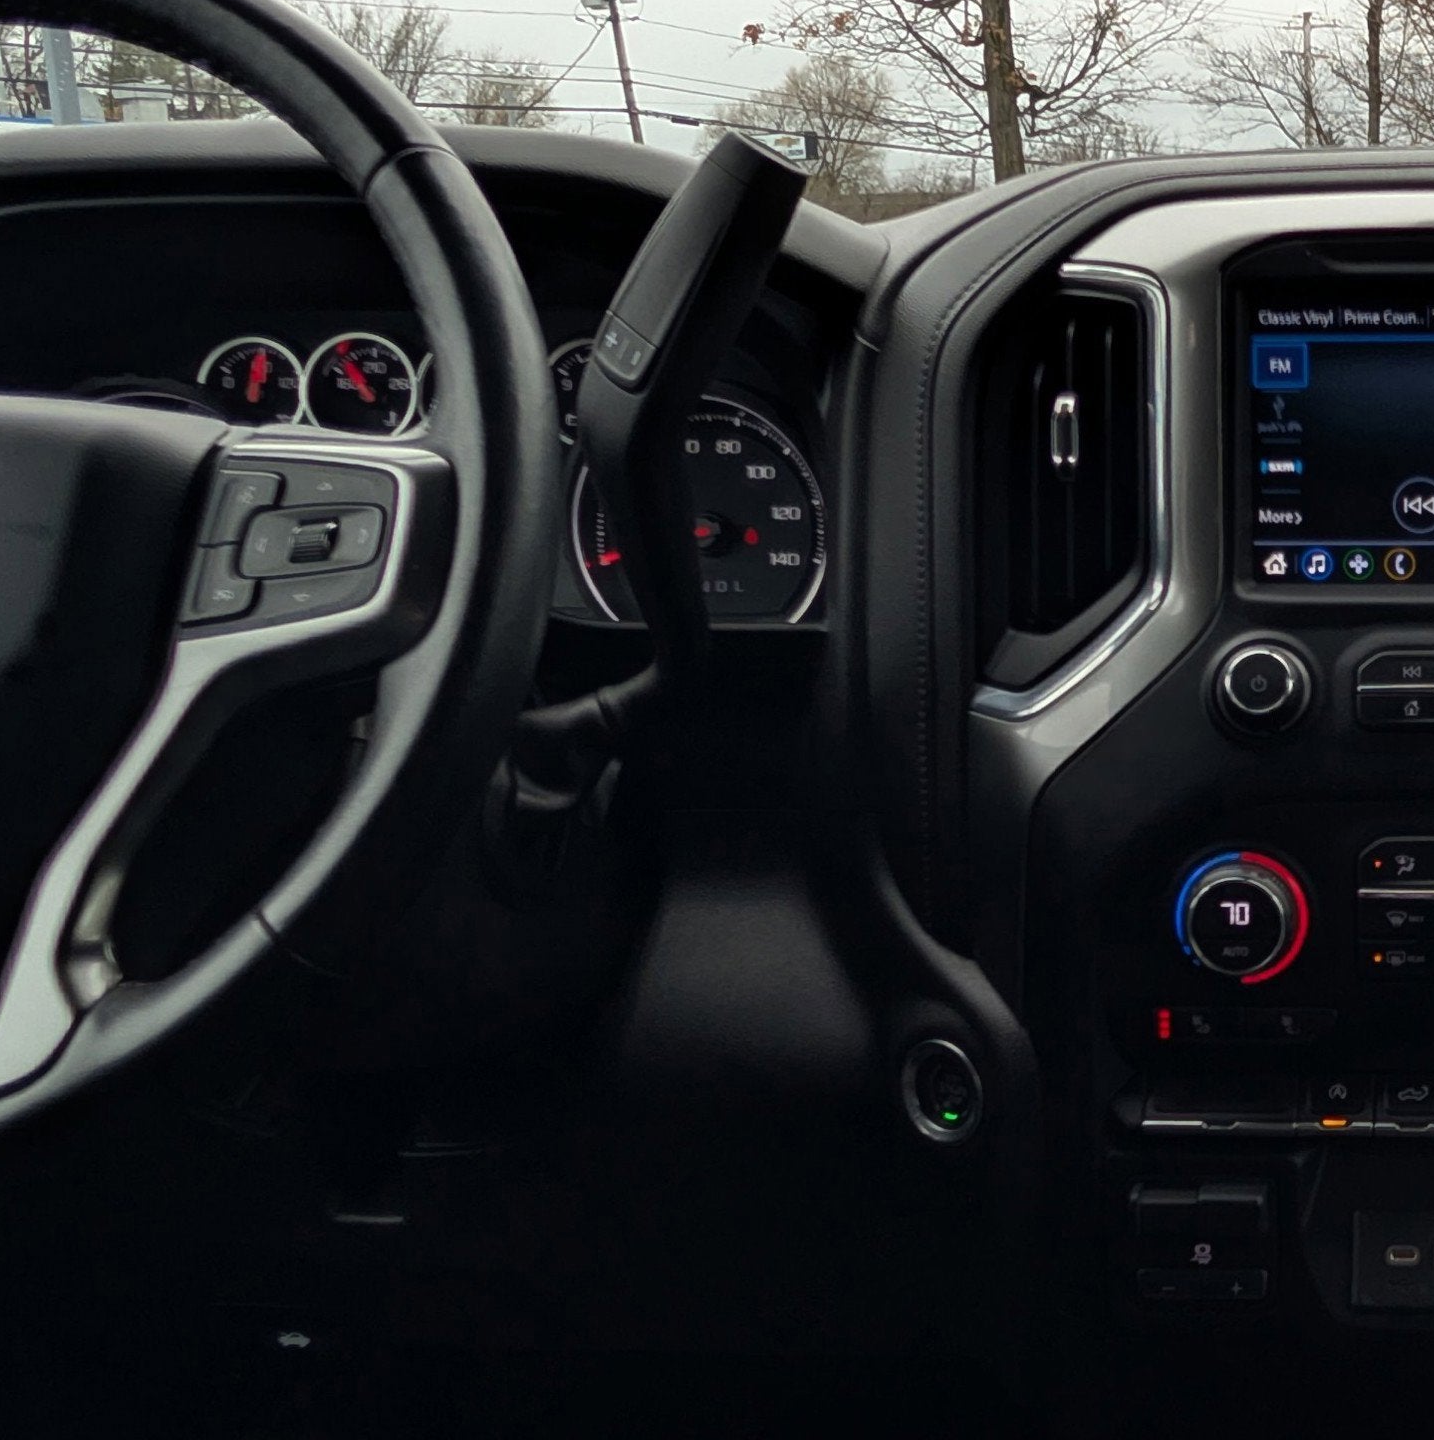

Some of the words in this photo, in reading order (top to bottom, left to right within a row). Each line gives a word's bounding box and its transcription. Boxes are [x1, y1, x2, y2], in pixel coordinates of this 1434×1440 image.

[1258, 309, 1301, 326] Classic
[1303, 309, 1335, 328] Vinyl
[1343, 309, 1380, 326] Prime
[1269, 357, 1292, 374] FM
[746, 465, 776, 480] 100
[770, 505, 802, 521] 120
[1258, 509, 1294, 526] More
[769, 551, 801, 567] 140
[1219, 901, 1251, 926] 70
